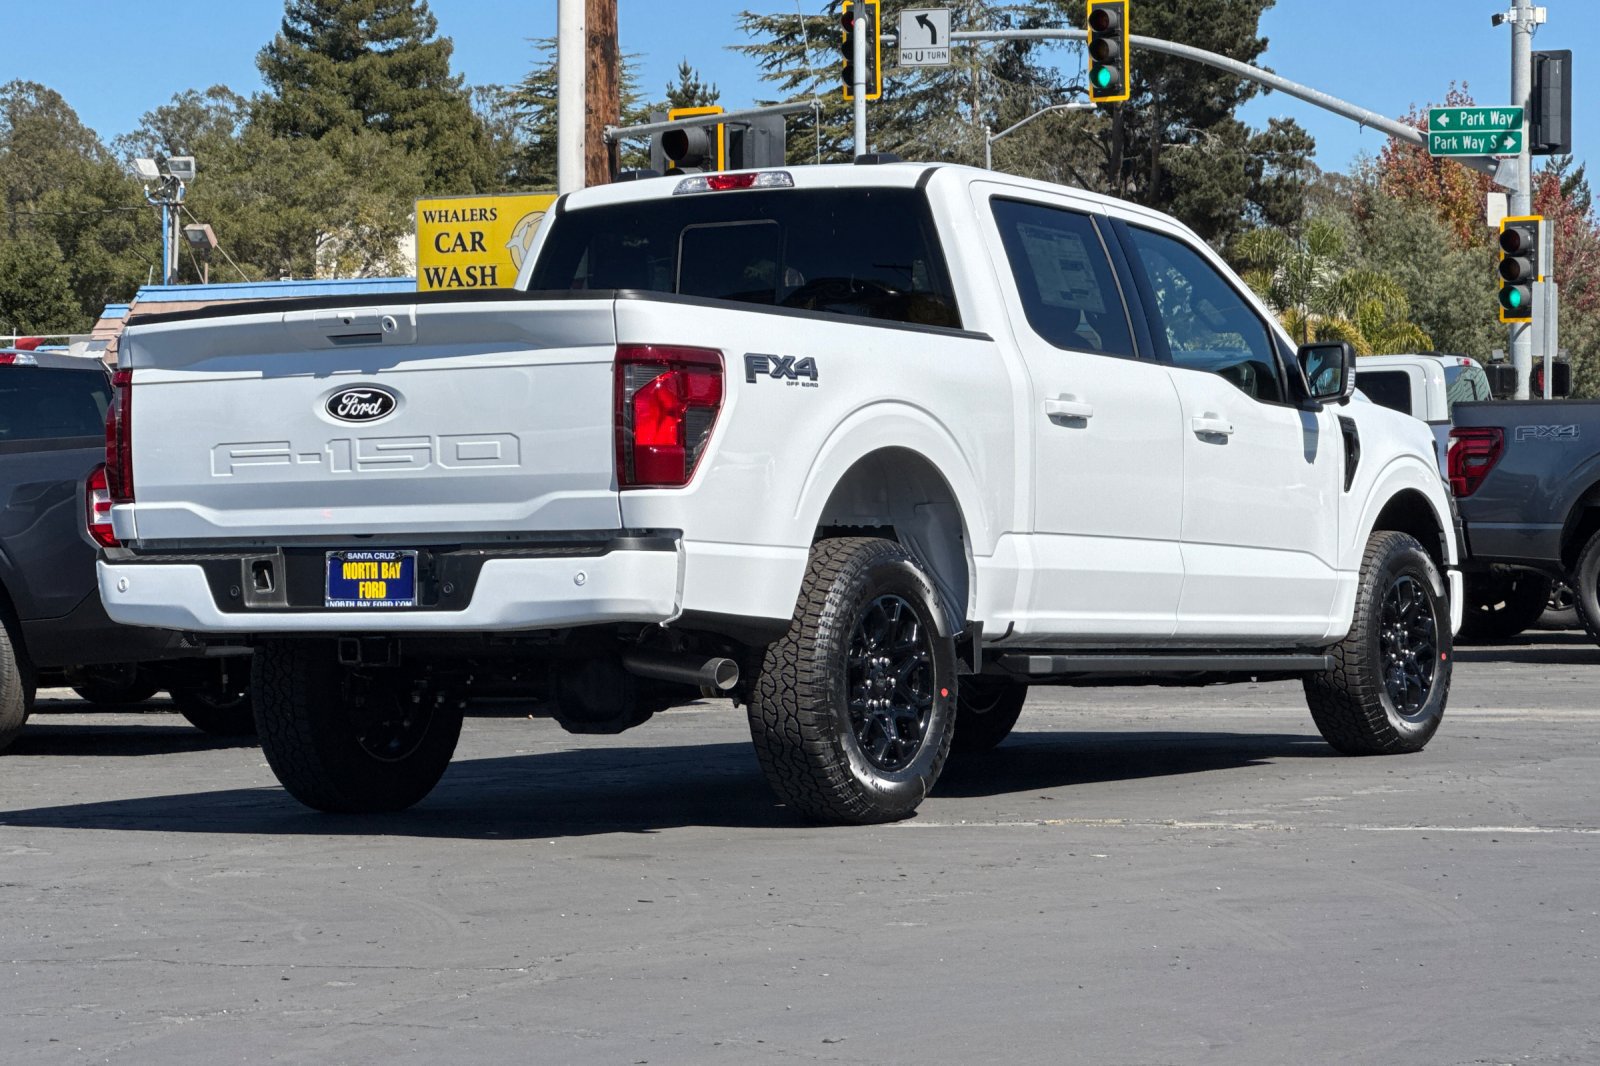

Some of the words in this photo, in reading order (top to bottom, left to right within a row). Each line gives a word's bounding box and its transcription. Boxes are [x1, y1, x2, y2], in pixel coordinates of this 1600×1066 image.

[915, 51, 923, 62] U
[927, 51, 947, 60] TURN
[1460, 111, 1485, 126] Park
[1490, 110, 1514, 128] Way
[1434, 136, 1458, 150] Park
[1462, 136, 1485, 152] Way
[1490, 135, 1497, 149] S
[422, 208, 497, 223] WHALERS
[434, 231, 487, 253] CAR
[424, 266, 498, 288] WASH
[743, 352, 819, 384] FX4
[337, 392, 382, 416] Ford
[1515, 424, 1580, 441] FX4
[210, 432, 521, 477] F-150
[374, 552, 396, 560] CRUZ
[343, 562, 378, 580] NORTH
[381, 562, 401, 579] BAY
[359, 581, 387, 599] FORD
